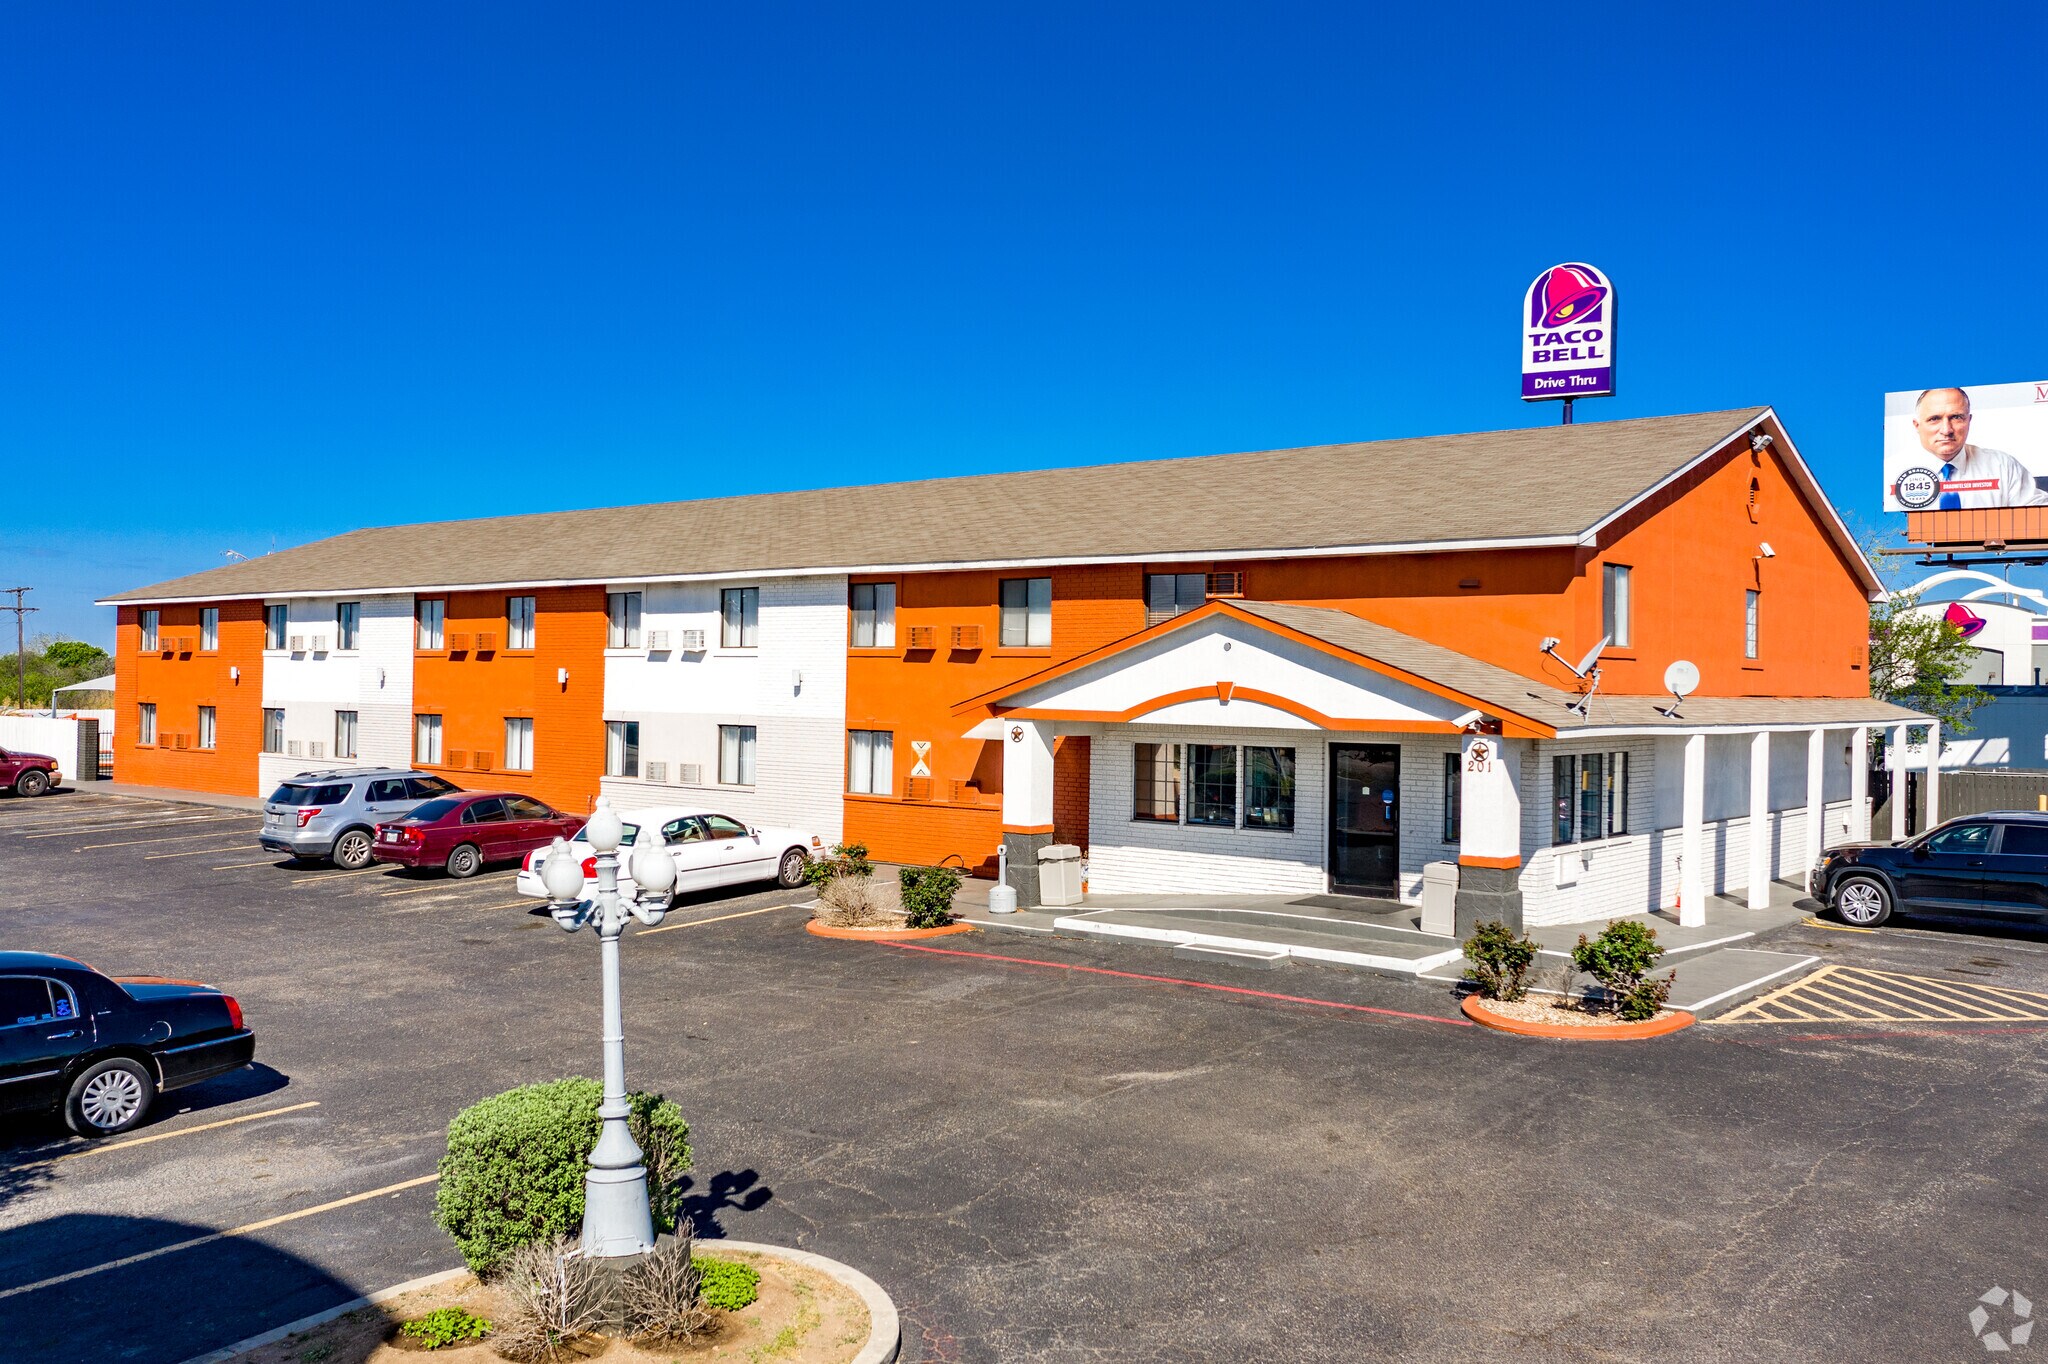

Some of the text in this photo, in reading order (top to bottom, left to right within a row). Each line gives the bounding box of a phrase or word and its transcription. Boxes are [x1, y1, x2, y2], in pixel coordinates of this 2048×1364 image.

[1528, 329, 1604, 347] TACO
[1532, 346, 1604, 364] BELL
[1534, 375, 1597, 389] Drive Thru
[1904, 481, 1931, 491] 1845
[1467, 760, 1491, 773] 201
